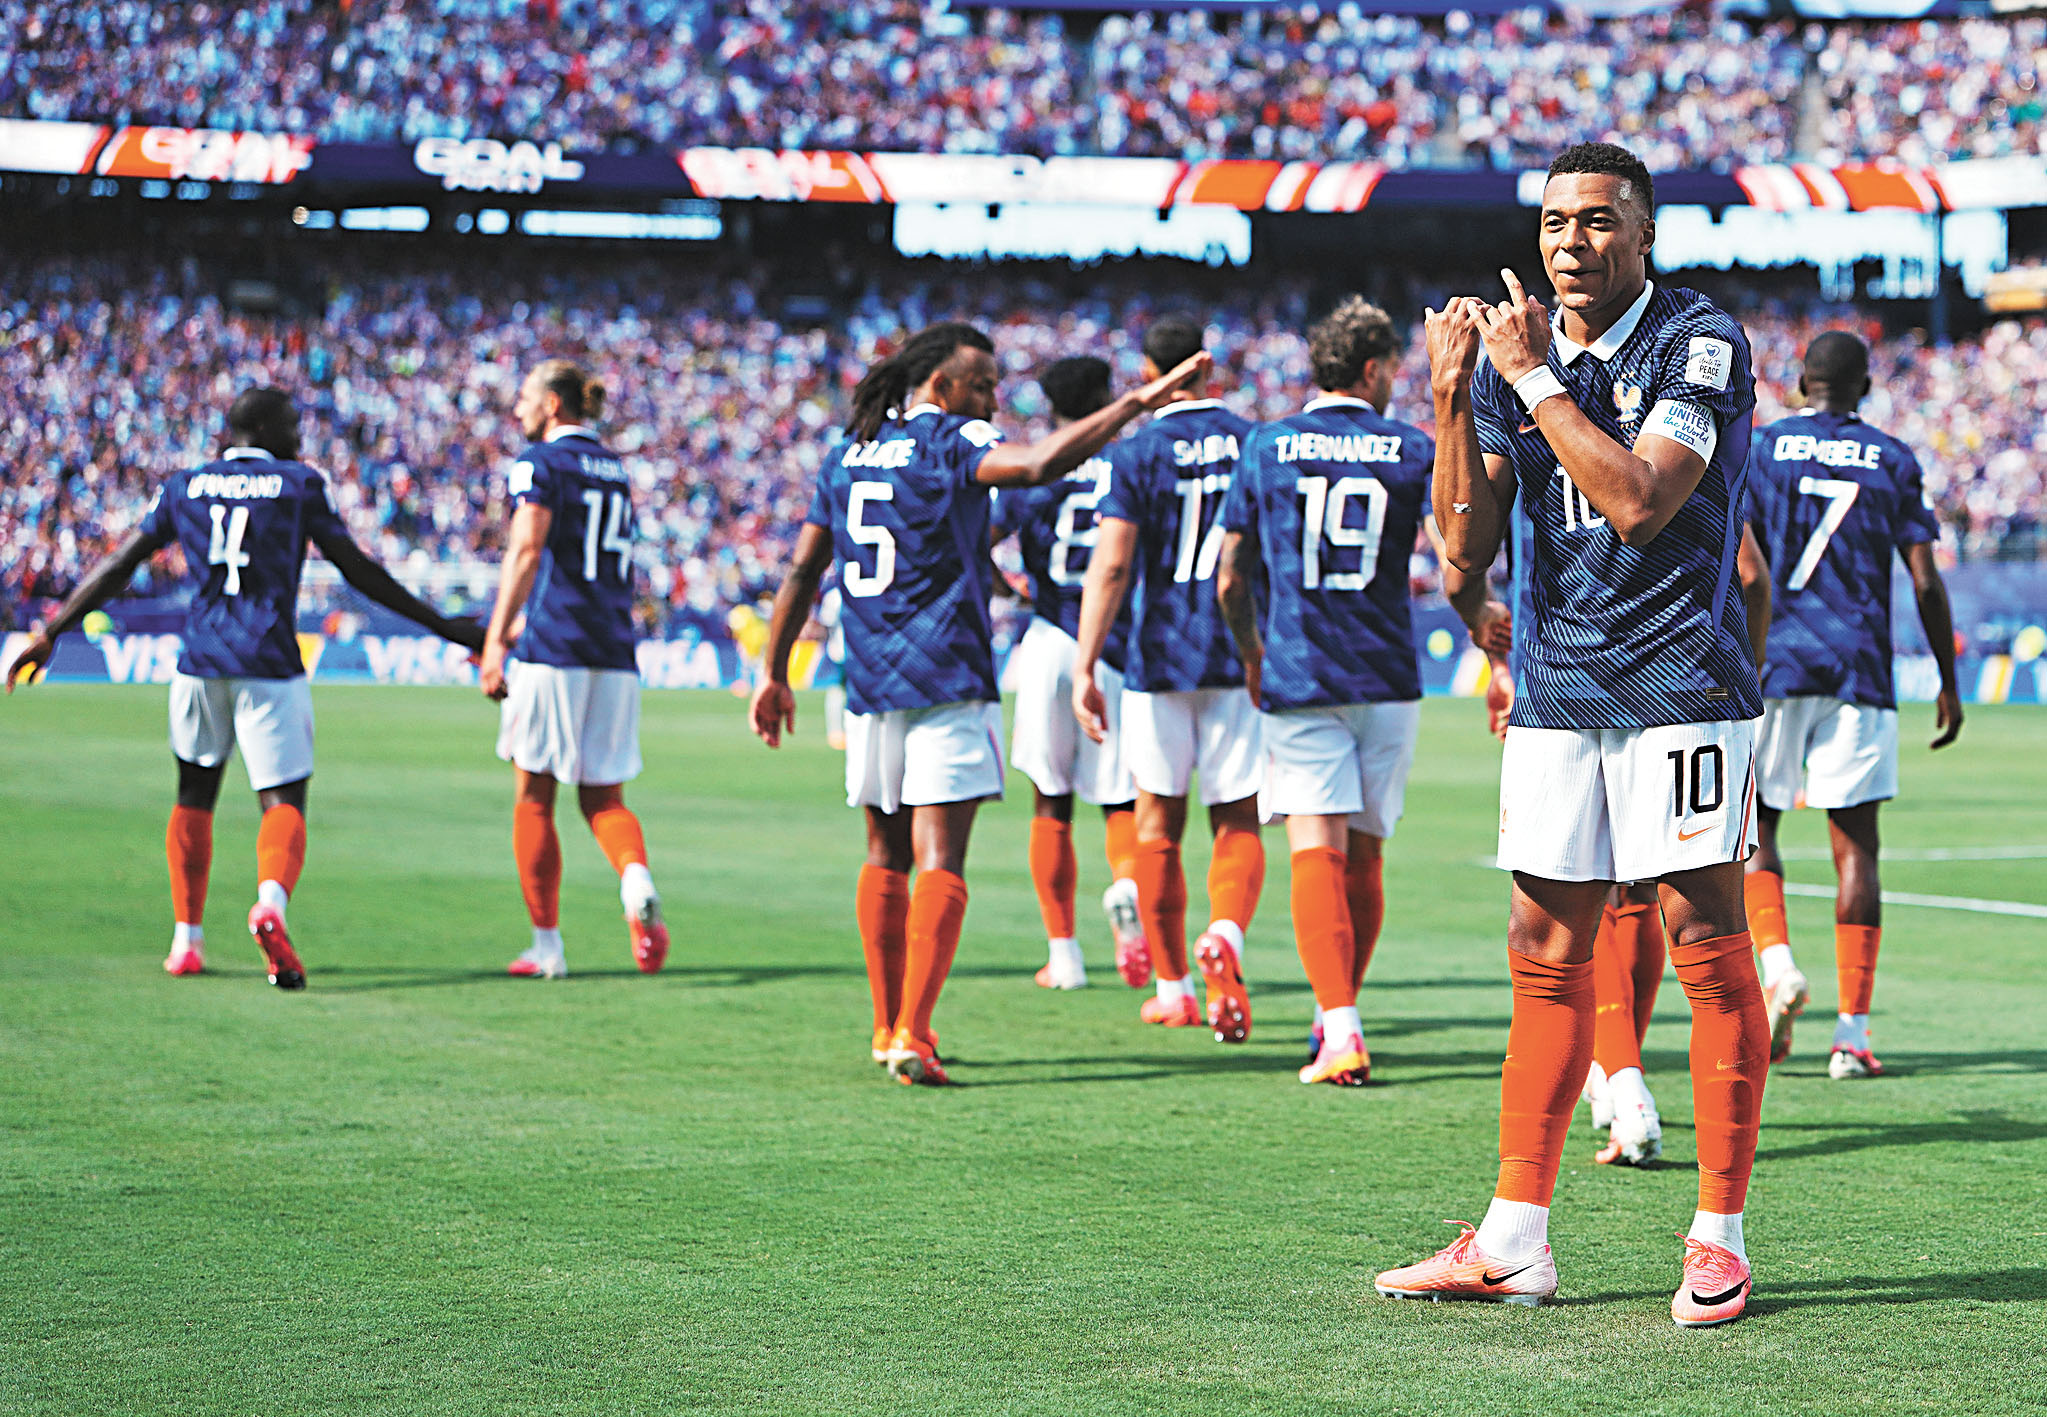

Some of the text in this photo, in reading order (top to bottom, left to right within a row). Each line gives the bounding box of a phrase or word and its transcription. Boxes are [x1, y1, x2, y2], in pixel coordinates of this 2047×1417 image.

[414, 136, 586, 181] GOAL
[1699, 364, 1720, 377] PEACE
[1663, 416, 1710, 445] the World
[1668, 405, 1710, 433] UNITES
[1673, 400, 1711, 423] OOTBALL
[1275, 432, 1402, 464] T.HERNANDEZ
[208, 503, 250, 596] 4
[582, 488, 634, 583] 14
[843, 480, 896, 598] 5
[1173, 474, 1231, 583] 17
[1296, 475, 1389, 591] 19
[1787, 476, 1860, 591] 7
[100, 633, 184, 684] VIS
[1667, 743, 1724, 818] 10
